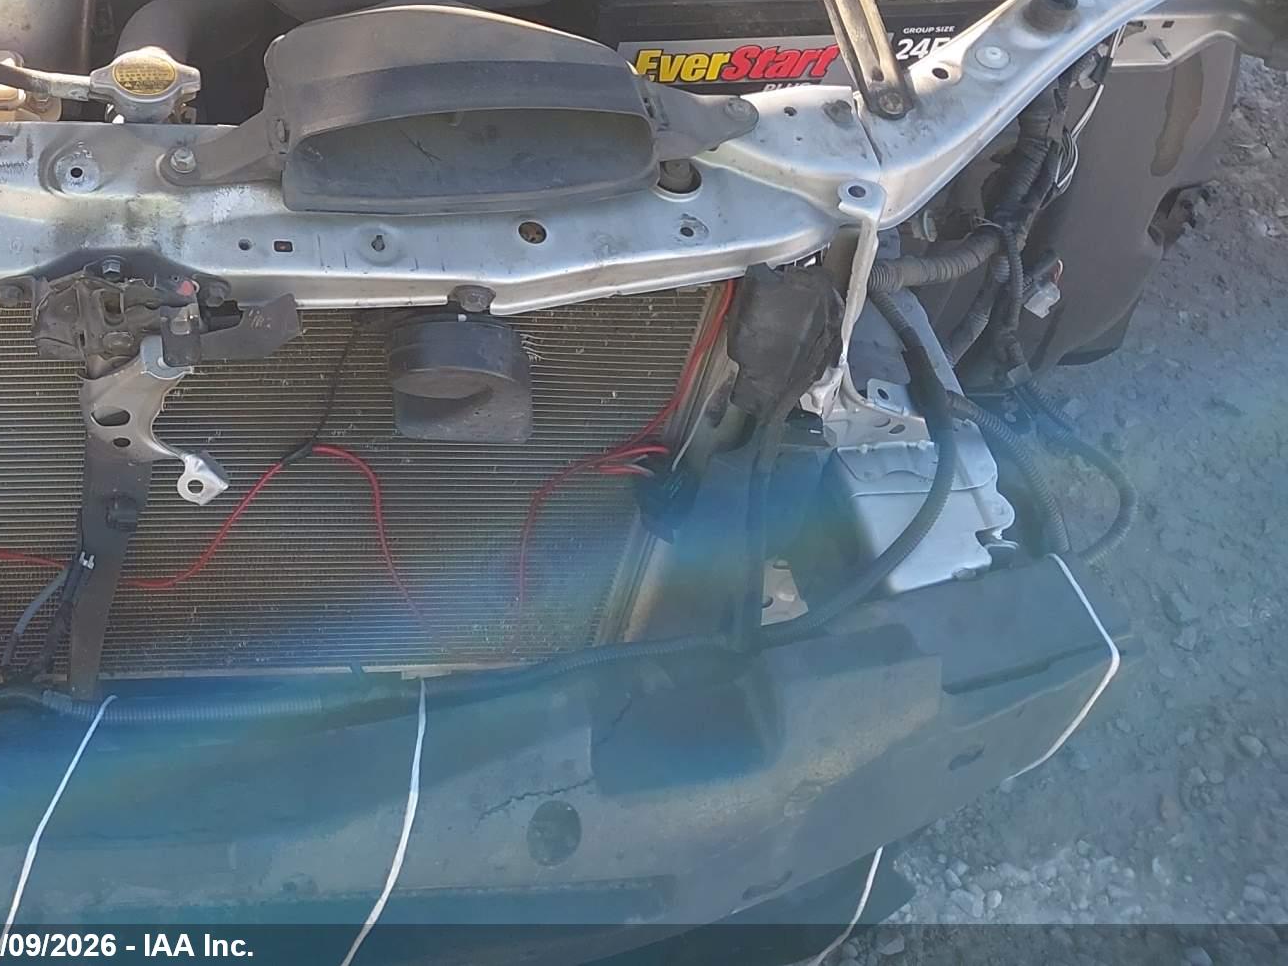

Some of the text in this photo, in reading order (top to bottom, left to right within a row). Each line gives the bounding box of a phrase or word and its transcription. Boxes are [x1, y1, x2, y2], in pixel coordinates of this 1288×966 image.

[903, 25, 956, 35] GROUP SIZE
[634, 42, 840, 84] EverStart
